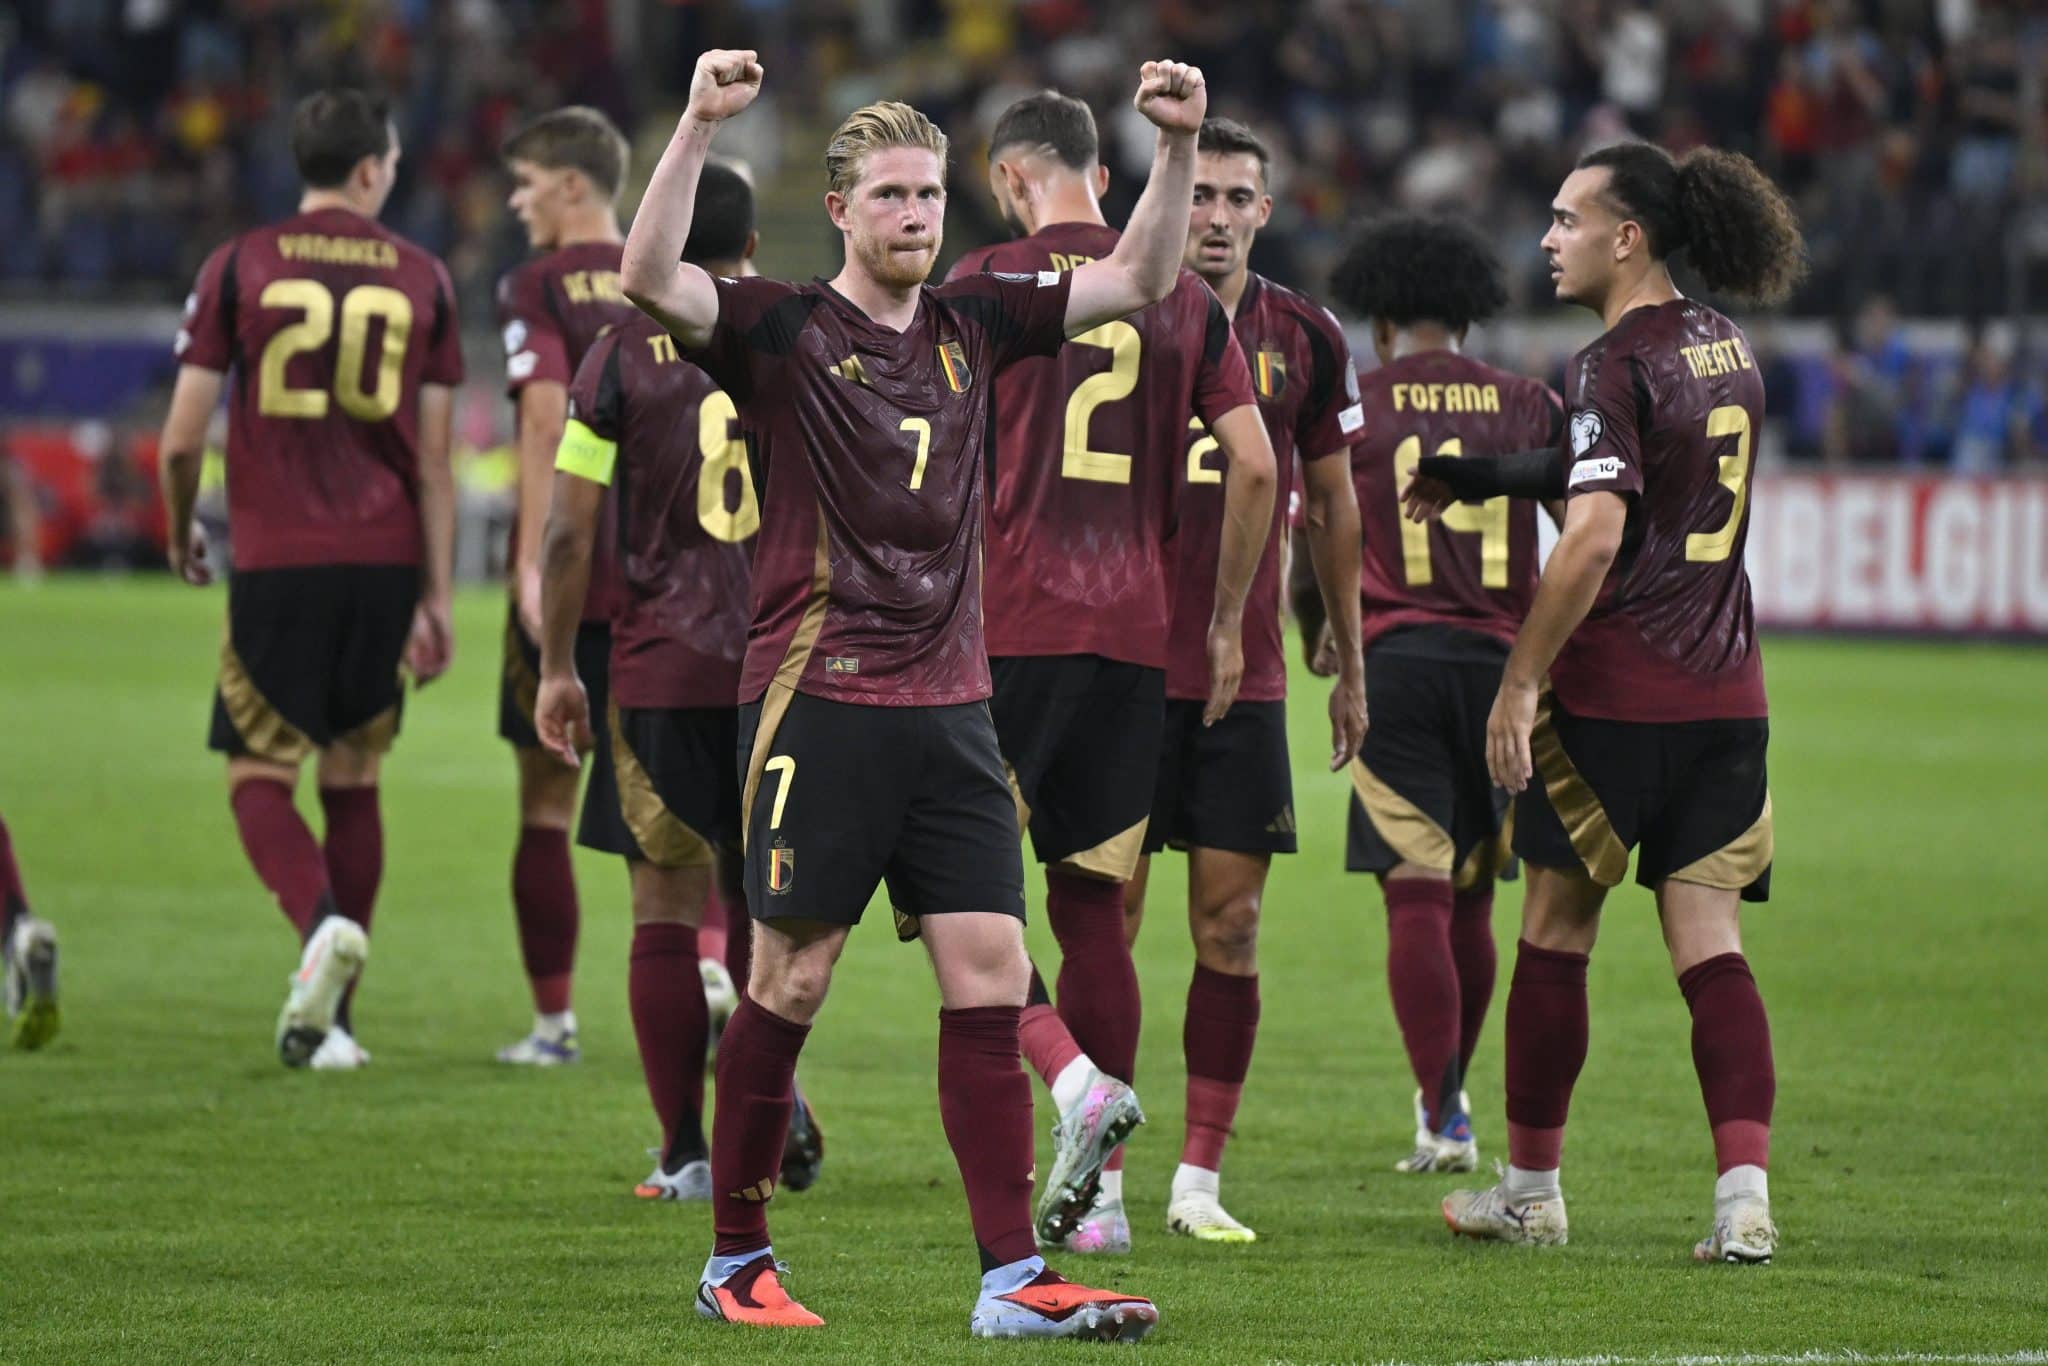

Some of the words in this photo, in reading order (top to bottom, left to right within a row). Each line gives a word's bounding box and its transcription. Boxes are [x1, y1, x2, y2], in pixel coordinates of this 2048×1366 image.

[259, 278, 413, 422] 20
[1062, 320, 1141, 484] 2
[1392, 384, 1500, 412] FOFANA
[1680, 337, 1751, 378] THEATE
[900, 417, 931, 489] 7
[1685, 404, 1750, 562] 3
[1394, 434, 1509, 588] 14
[764, 755, 796, 829] 7
